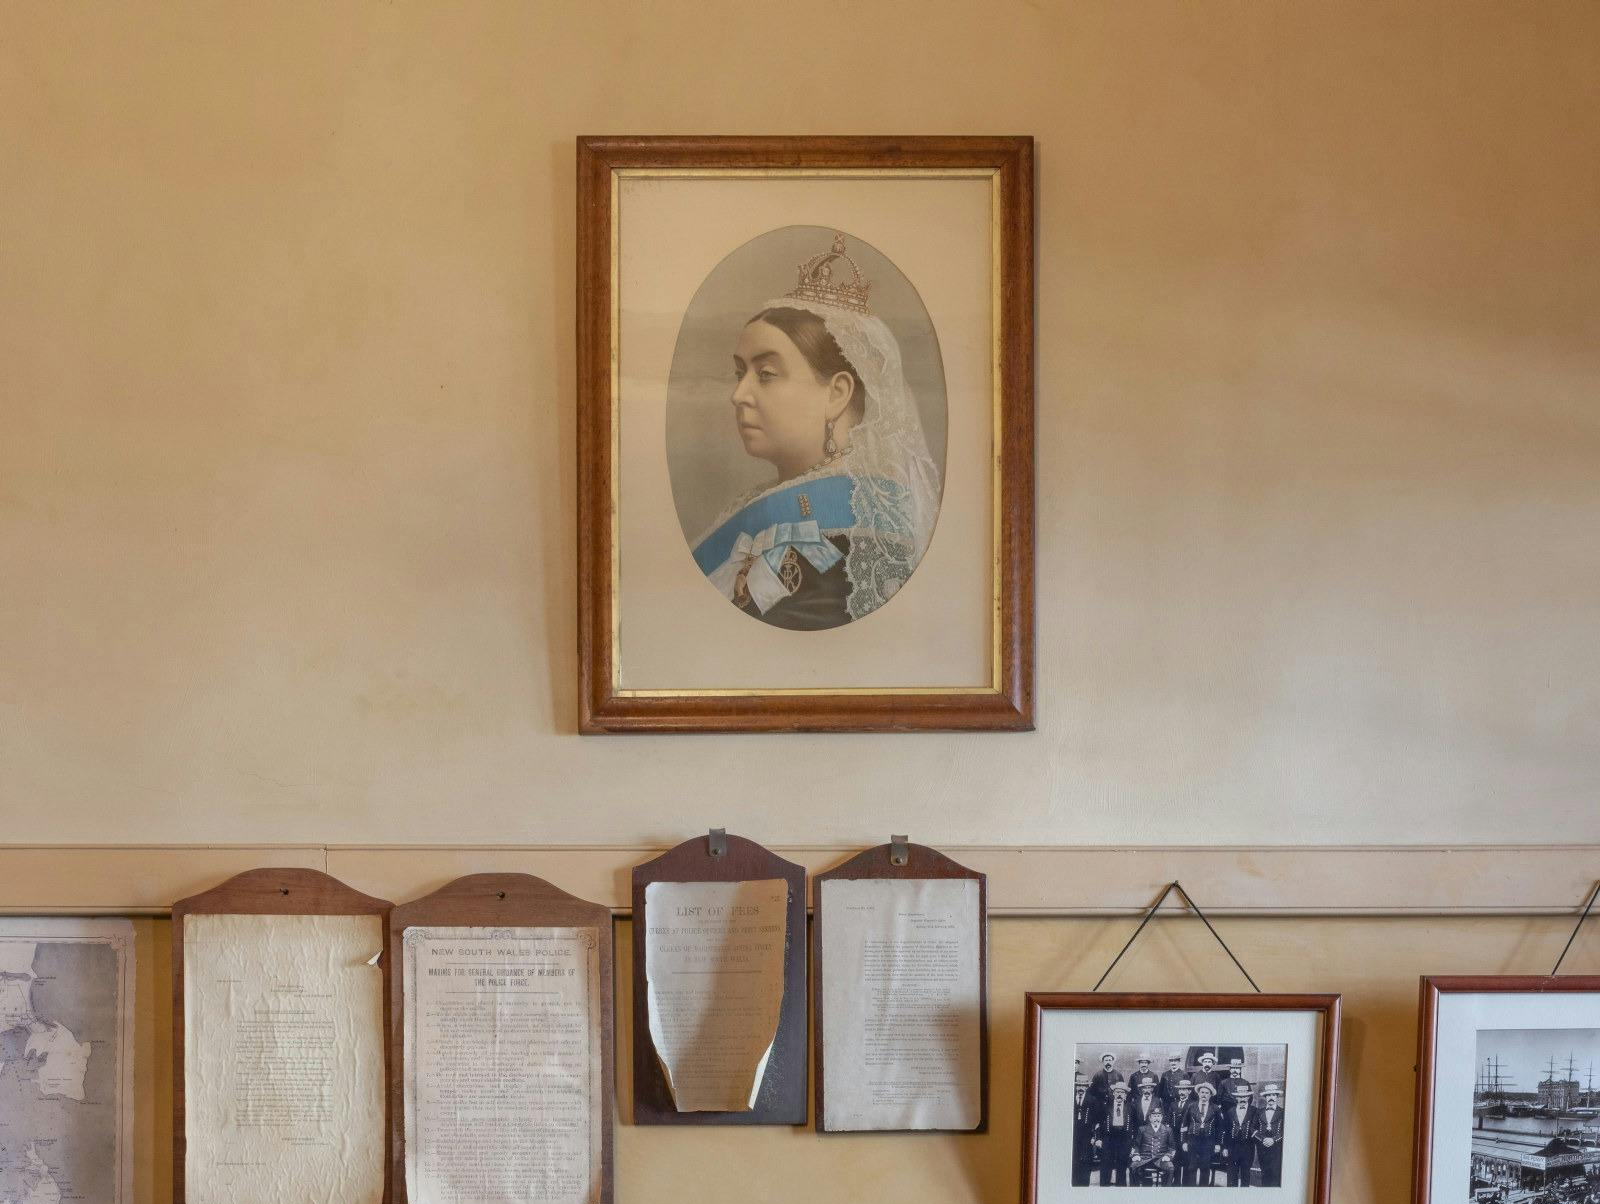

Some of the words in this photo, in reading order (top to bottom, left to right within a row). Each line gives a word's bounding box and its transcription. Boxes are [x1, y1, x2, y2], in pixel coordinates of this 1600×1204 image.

[676, 906, 702, 917] LIST
[707, 906, 724, 917] OF
[731, 905, 760, 917] FEES
[454, 968, 467, 976] FOR
[468, 968, 493, 976] GENERAL
[528, 968, 535, 976] OF
[538, 968, 565, 976] MEMBERS
[568, 968, 576, 976] OF
[474, 979, 485, 987] THE
[488, 979, 507, 987] POLICE
